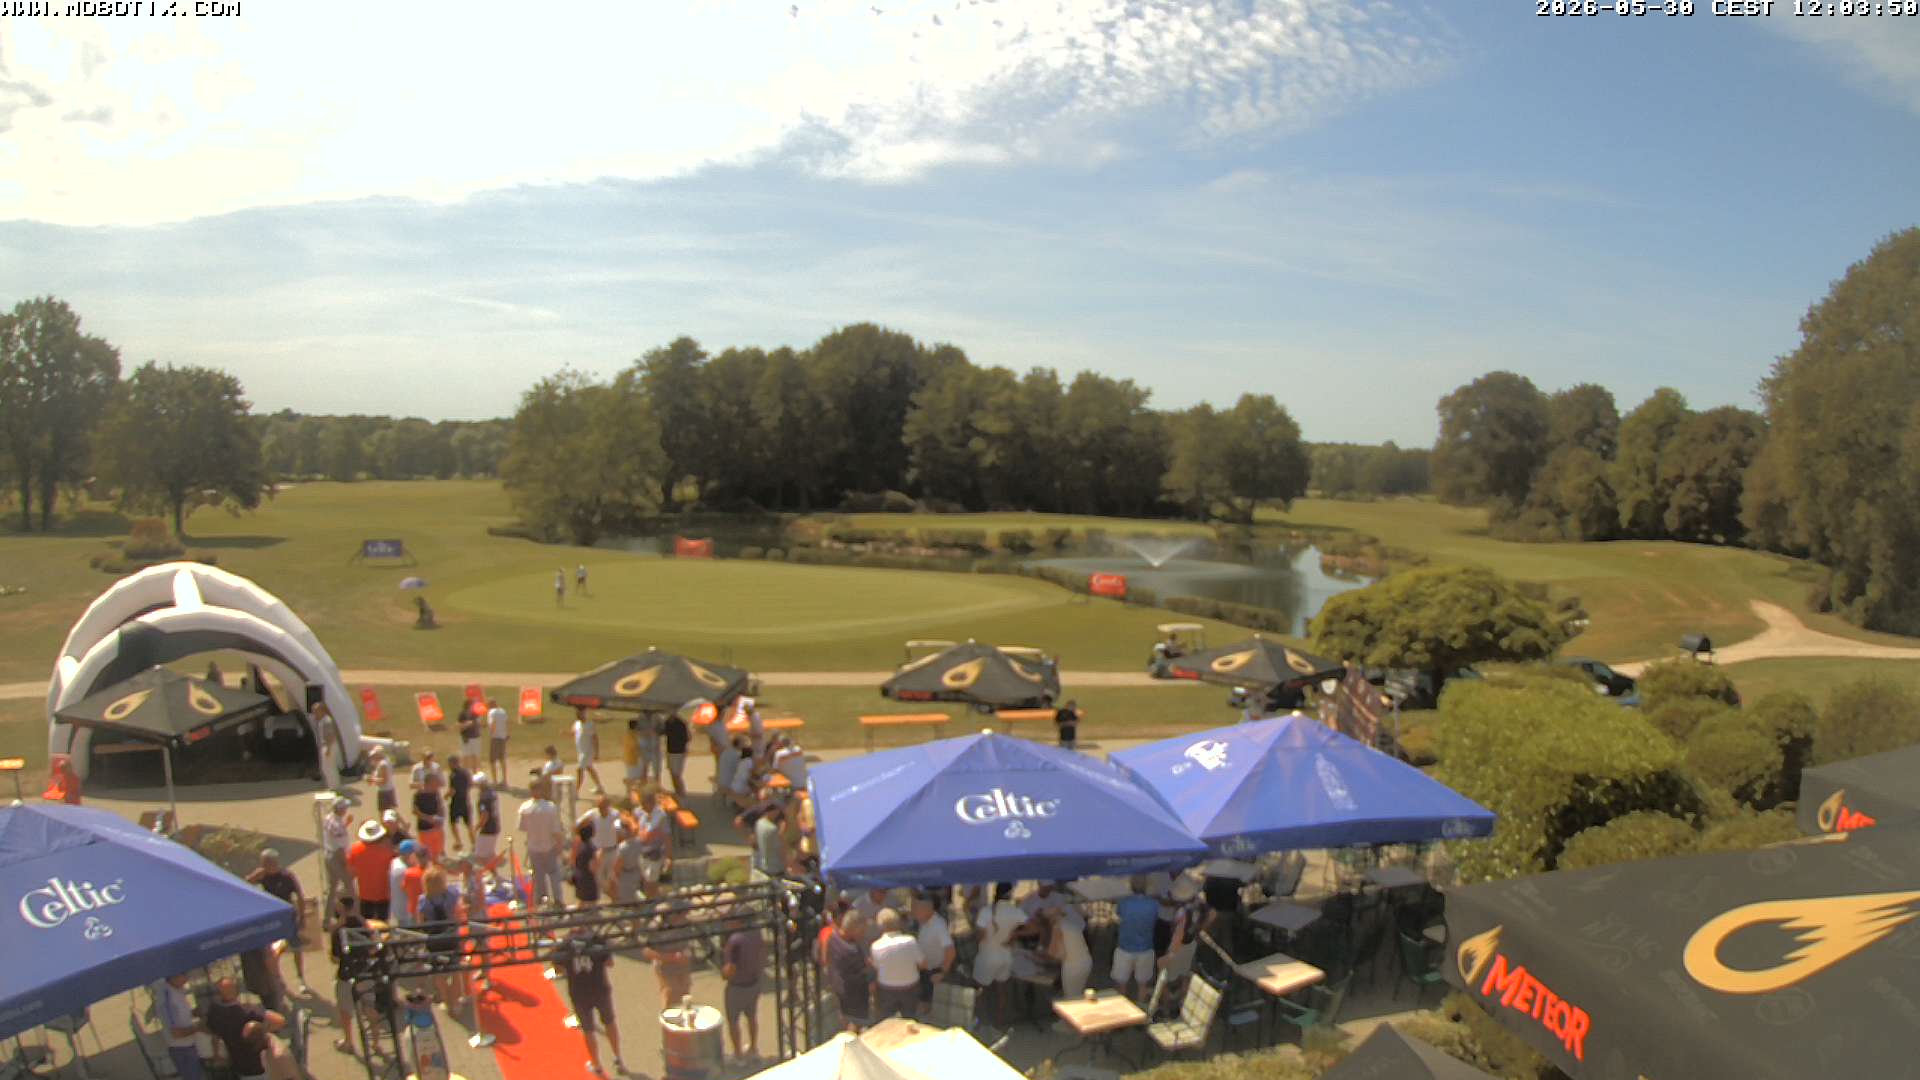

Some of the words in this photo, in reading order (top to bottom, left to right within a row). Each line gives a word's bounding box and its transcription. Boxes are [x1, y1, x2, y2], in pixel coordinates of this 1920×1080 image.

[956, 788, 1057, 824] Celtic
[19, 877, 126, 928] Celtic
[1481, 953, 1592, 1062] METEOR
